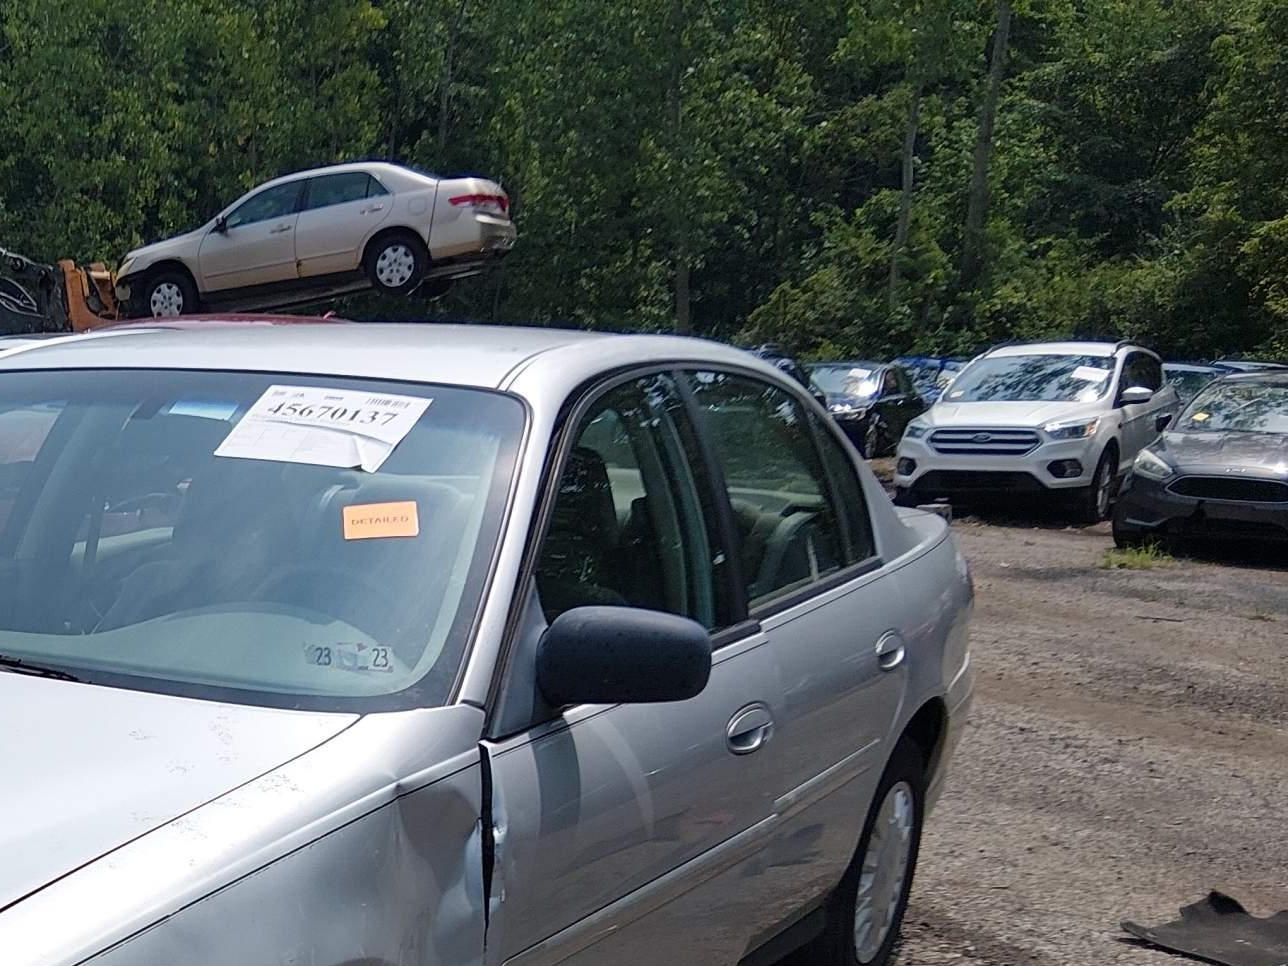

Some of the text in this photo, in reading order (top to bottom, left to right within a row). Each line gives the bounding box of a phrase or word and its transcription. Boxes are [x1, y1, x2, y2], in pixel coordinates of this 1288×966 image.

[267, 402, 398, 427] 45670137
[351, 515, 410, 526] DETAILED
[315, 646, 332, 666] 23
[372, 647, 389, 668] 23
